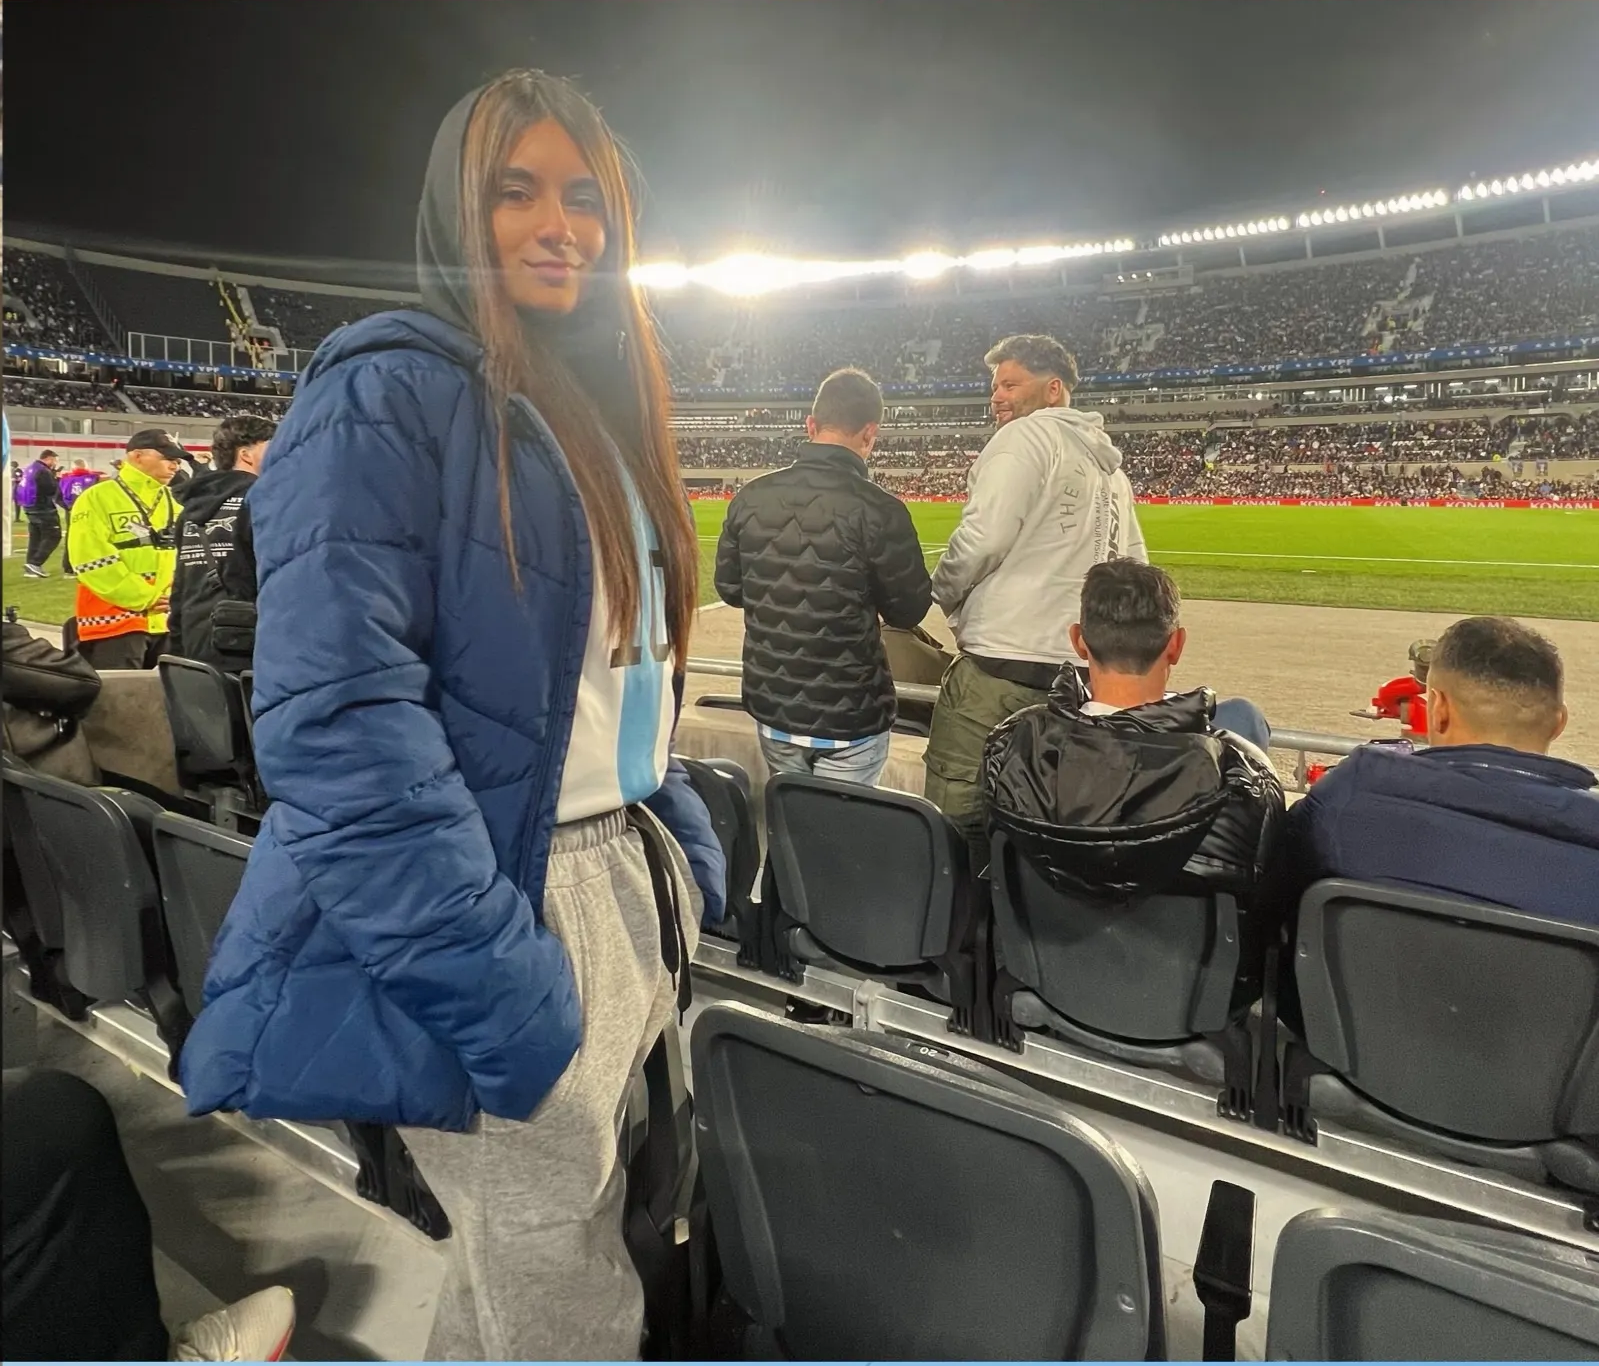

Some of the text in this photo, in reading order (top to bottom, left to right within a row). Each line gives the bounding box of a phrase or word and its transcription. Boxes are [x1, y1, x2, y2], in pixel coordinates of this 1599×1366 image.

[1329, 358, 1354, 367] YPF
[1405, 351, 1433, 361] YPF
[1488, 344, 1518, 353] YPF
[1580, 337, 1599, 345] YP
